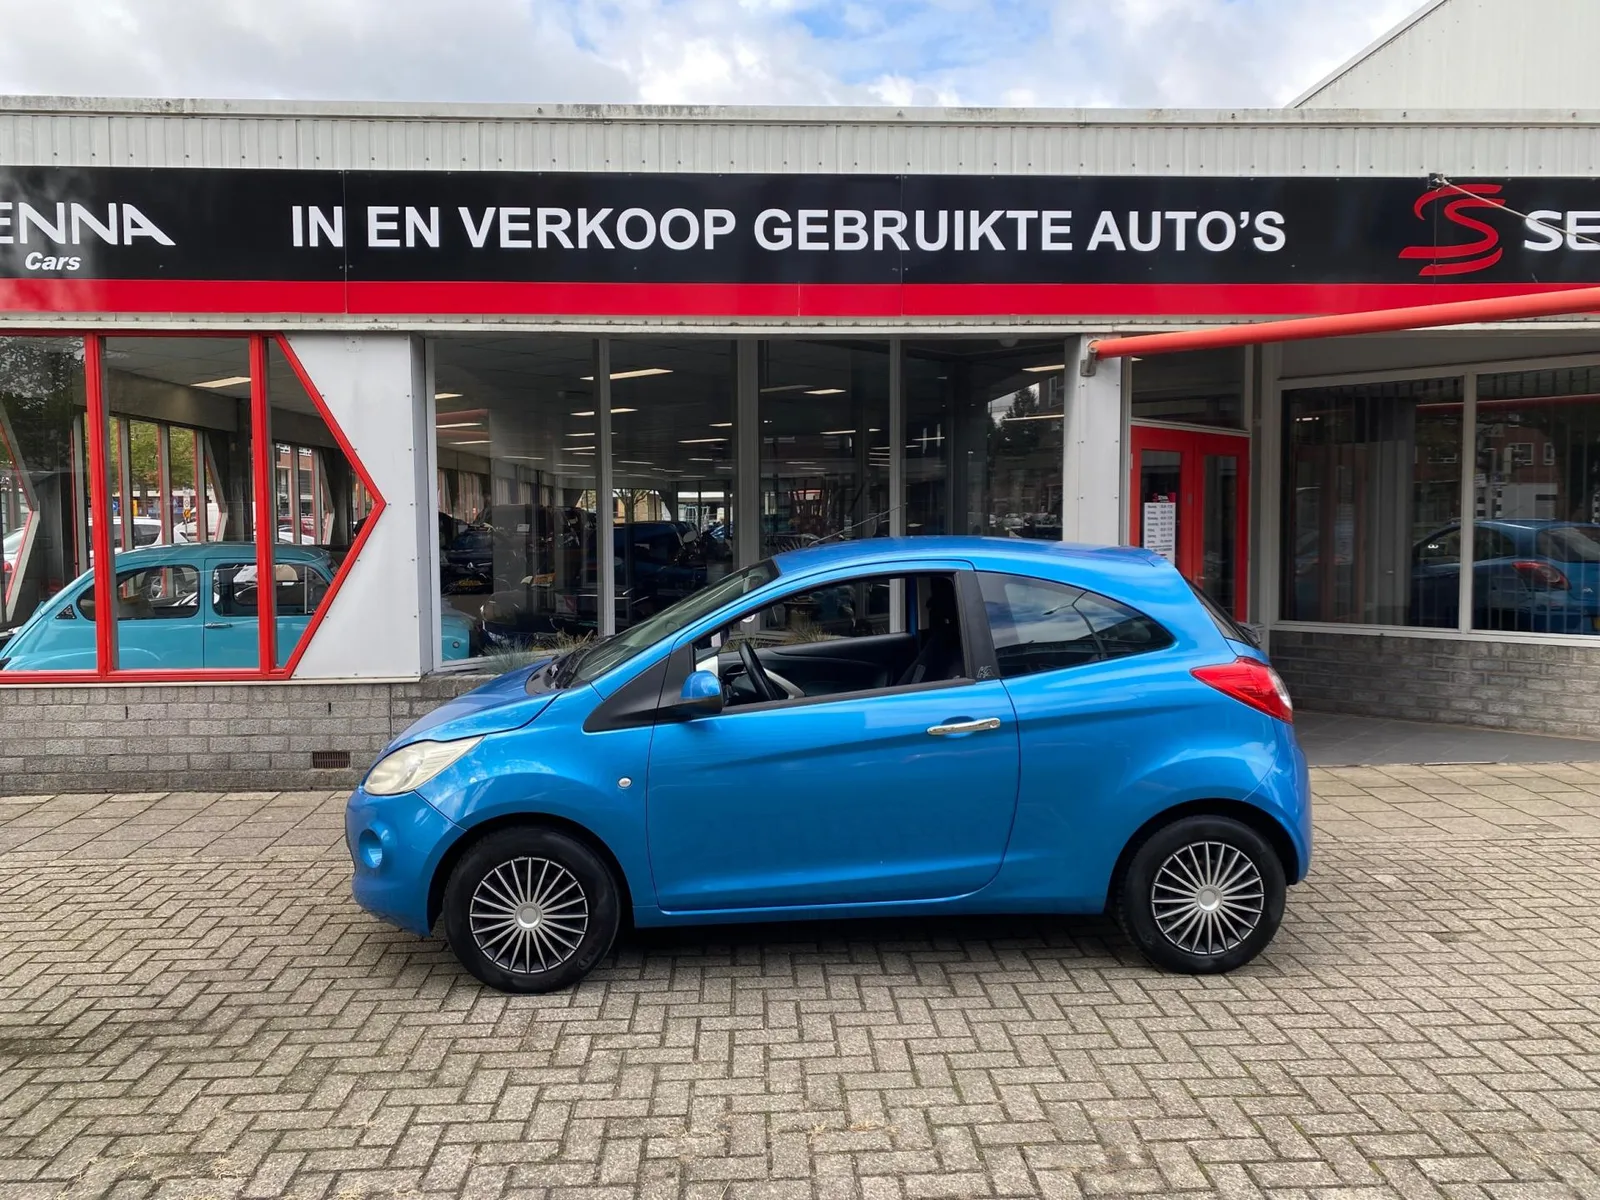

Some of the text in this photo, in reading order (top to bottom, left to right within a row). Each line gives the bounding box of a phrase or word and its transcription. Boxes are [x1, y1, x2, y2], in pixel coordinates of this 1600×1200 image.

[292, 205, 1286, 252] IN EN VERKOOP GEBRUIKTE AUTO'S
[24, 251, 82, 271] Cars
